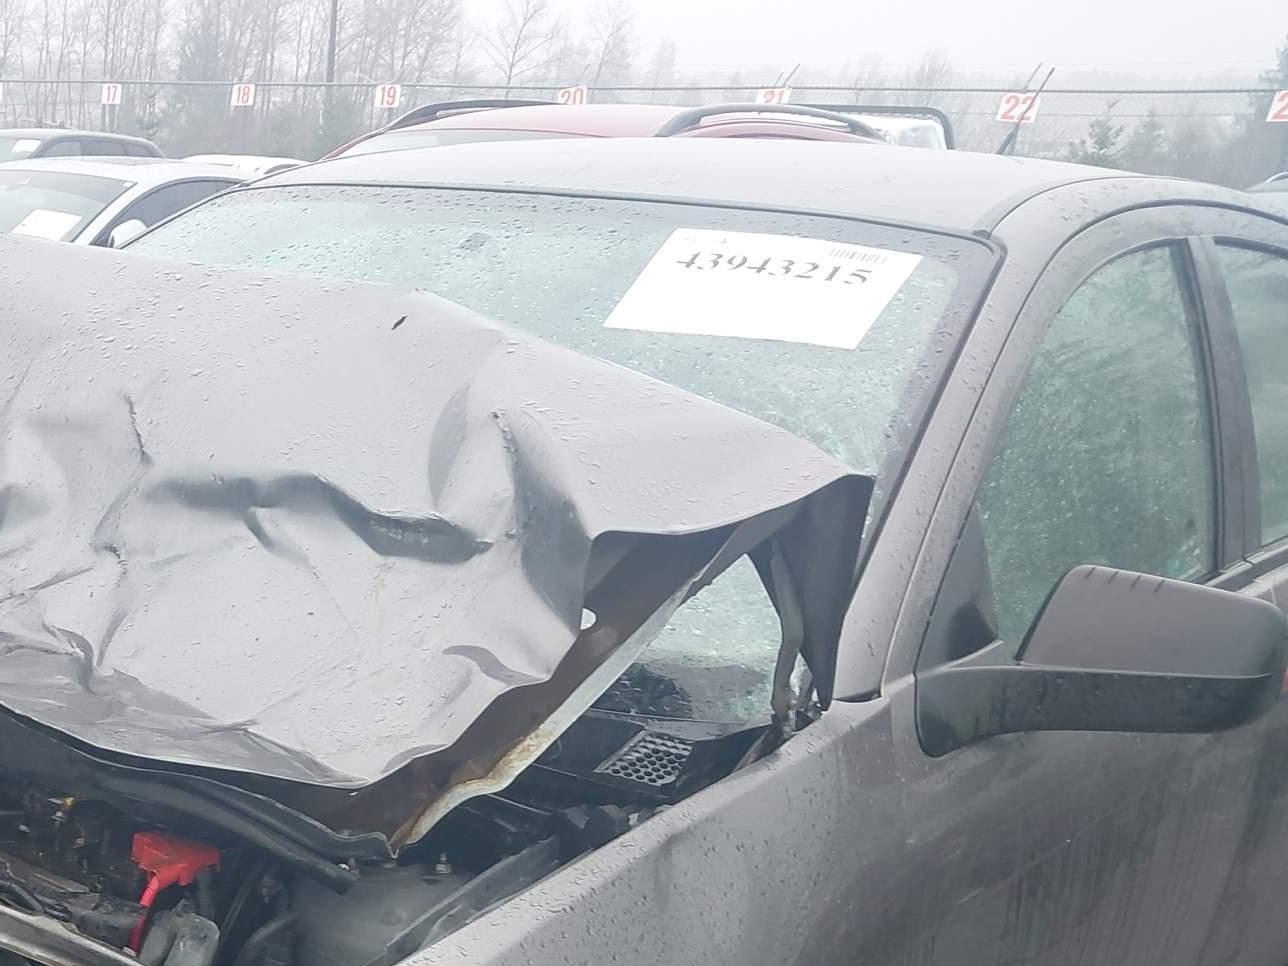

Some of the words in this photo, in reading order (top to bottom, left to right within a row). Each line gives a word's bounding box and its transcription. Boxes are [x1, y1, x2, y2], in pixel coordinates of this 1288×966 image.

[106, 85, 118, 103] 17
[236, 85, 251, 104] 18
[380, 86, 397, 105] 19
[560, 87, 584, 104] 20
[999, 94, 1035, 121] 22
[676, 250, 873, 285] 43943215
